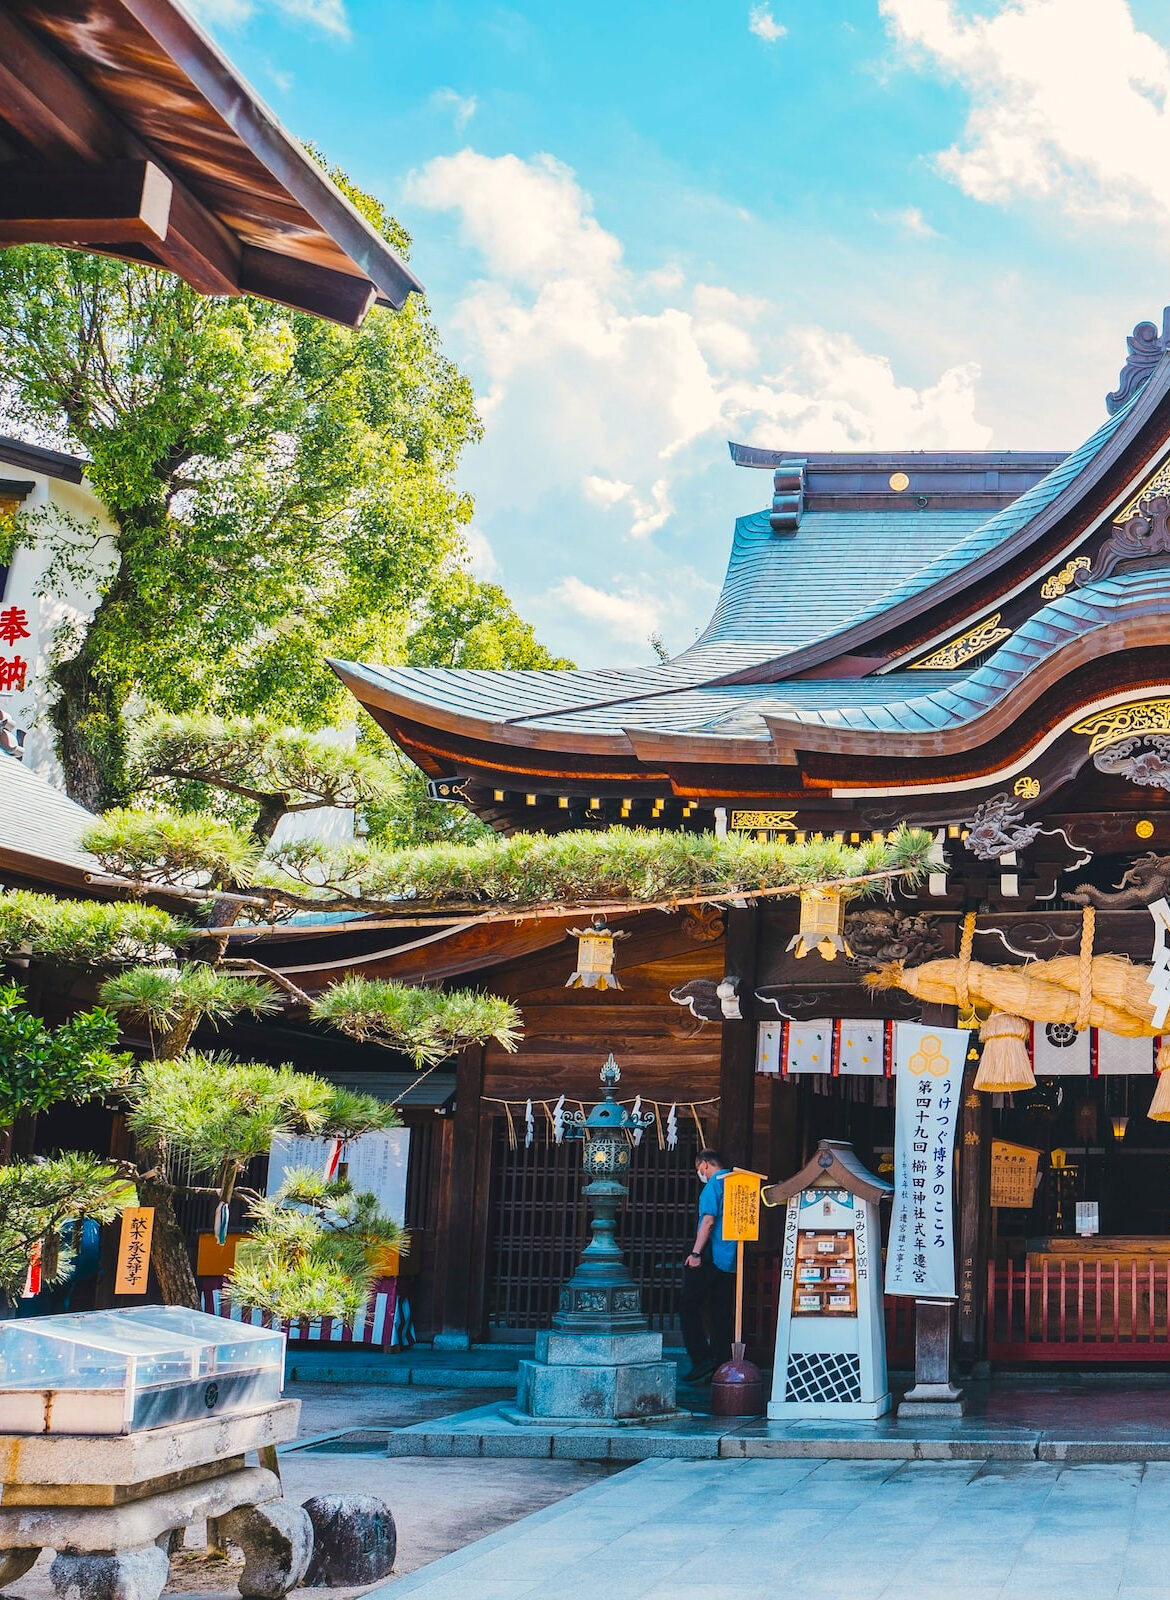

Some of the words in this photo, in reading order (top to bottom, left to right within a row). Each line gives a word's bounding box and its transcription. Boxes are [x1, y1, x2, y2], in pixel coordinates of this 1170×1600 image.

[0, 606, 31, 692] 奉納
[933, 1080, 952, 1248] うけつぐ博多のこころ
[783, 1210, 797, 1280] おみくじ100円
[855, 1210, 868, 1280] おみくじ100円
